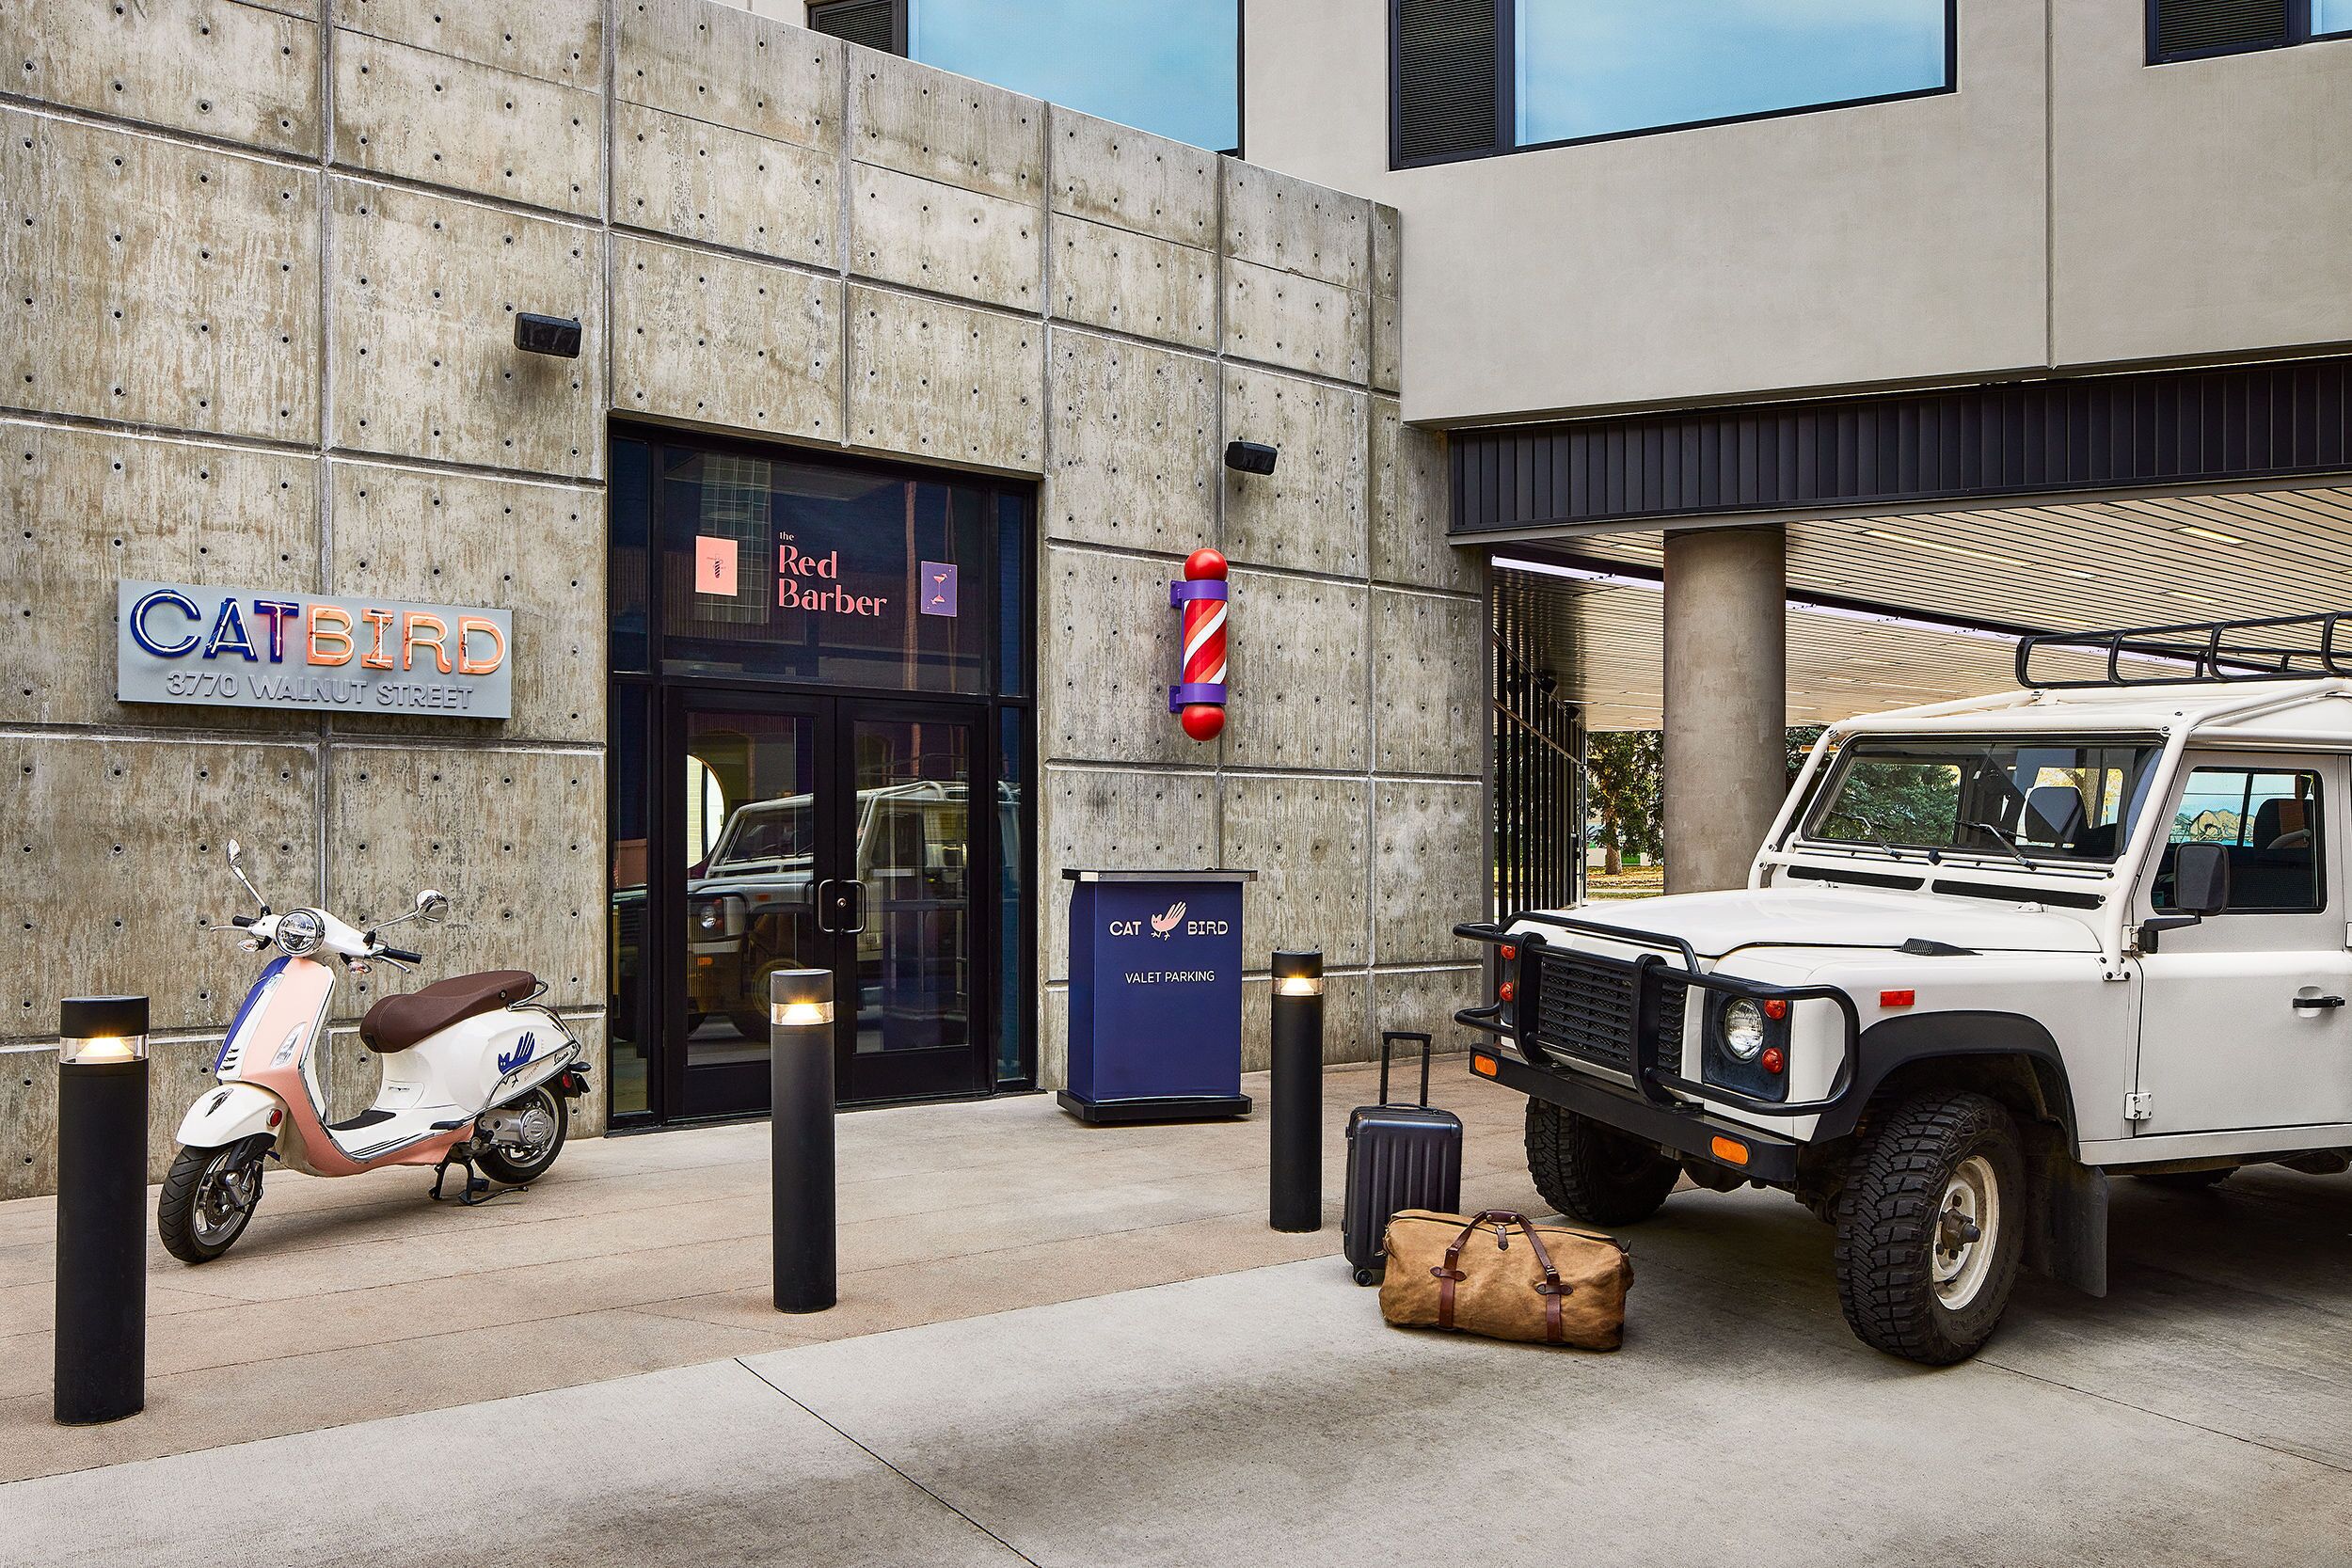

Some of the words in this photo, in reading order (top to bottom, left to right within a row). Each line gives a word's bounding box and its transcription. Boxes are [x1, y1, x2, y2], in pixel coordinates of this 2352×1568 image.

[779, 531, 795, 541] the
[779, 545, 837, 578] Red
[779, 578, 887, 616] Barber
[129, 589, 506, 674] CATBIRD
[167, 673, 239, 697] 3770
[249, 674, 367, 704] WALNUT
[376, 681, 473, 709] STREET
[1109, 921, 1141, 936] CAT
[1187, 921, 1229, 935] BIRD
[1125, 972, 1161, 984] VALET
[1165, 971, 1215, 983] PARKING
